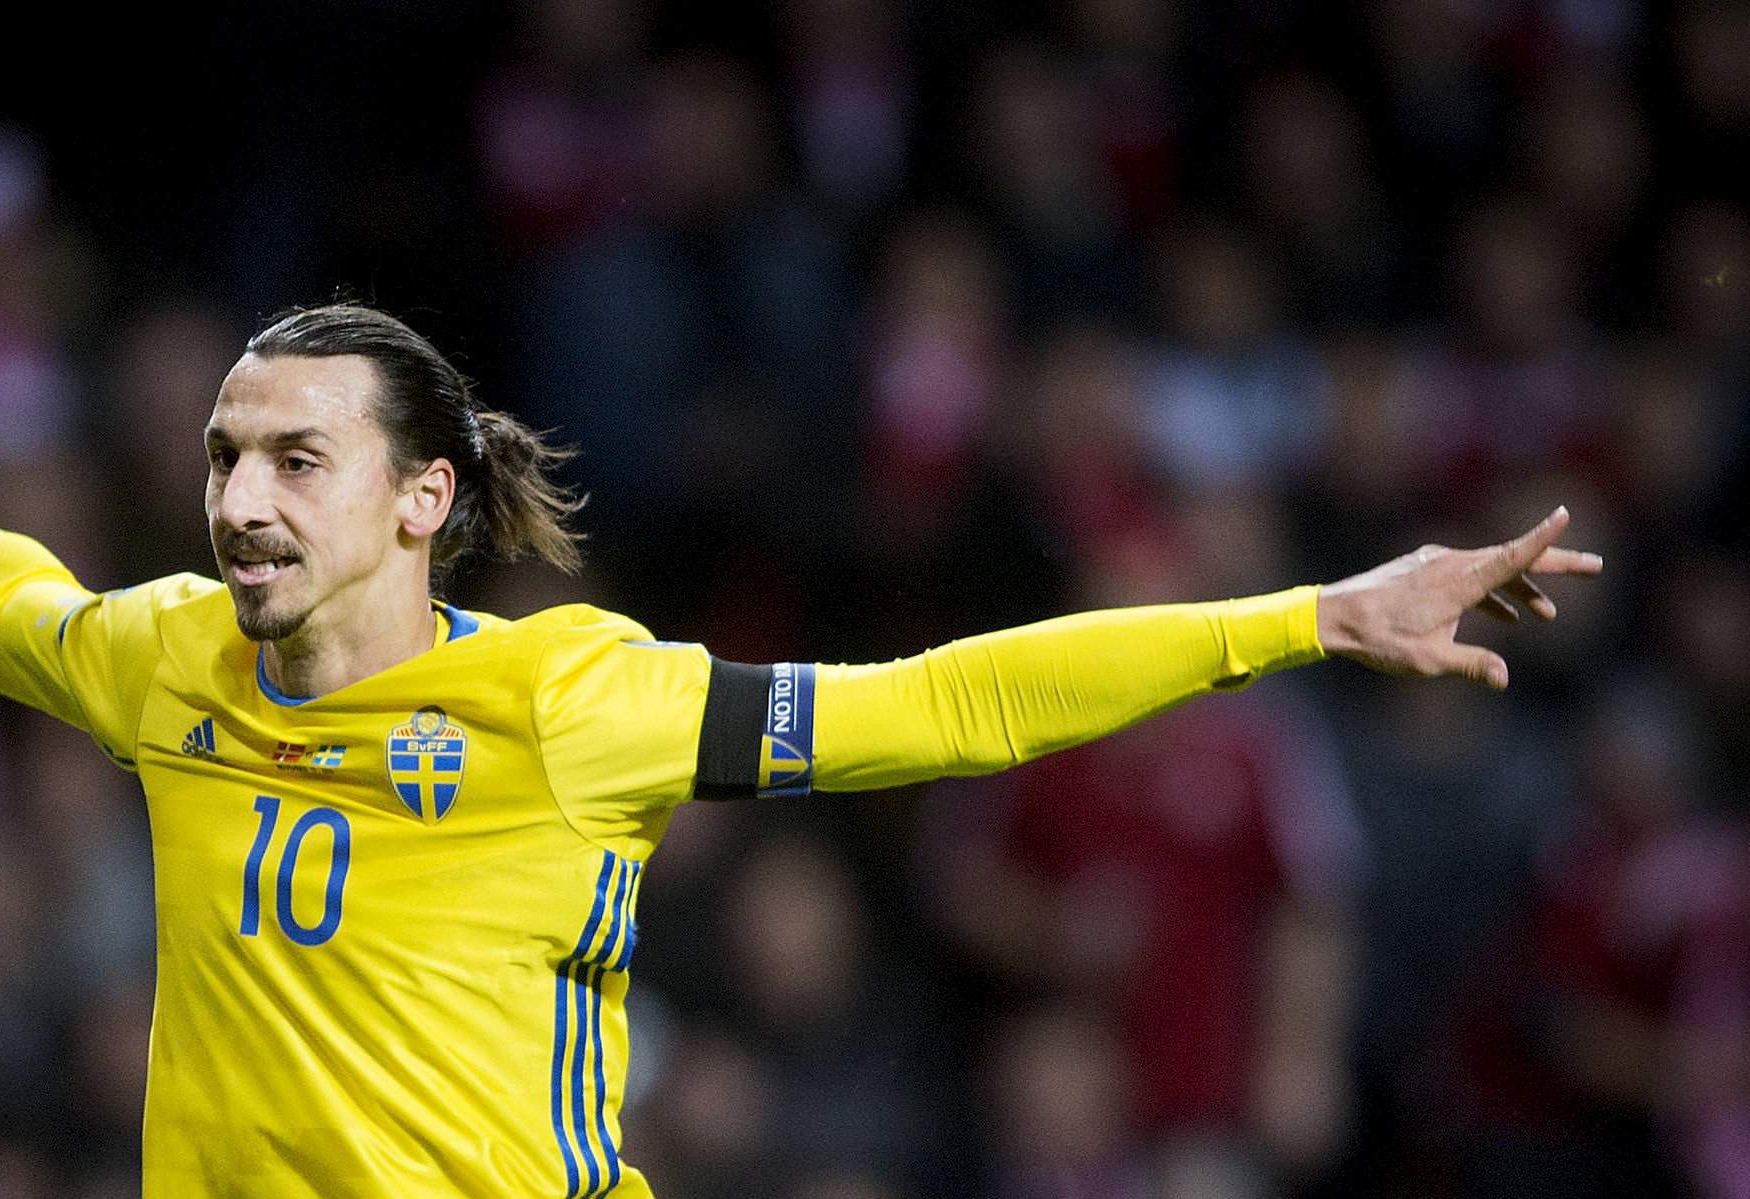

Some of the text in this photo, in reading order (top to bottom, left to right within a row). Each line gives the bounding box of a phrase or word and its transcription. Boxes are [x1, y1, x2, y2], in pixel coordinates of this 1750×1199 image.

[774, 679, 792, 701] TO
[774, 701, 791, 733] NO
[239, 794, 351, 947] 10
